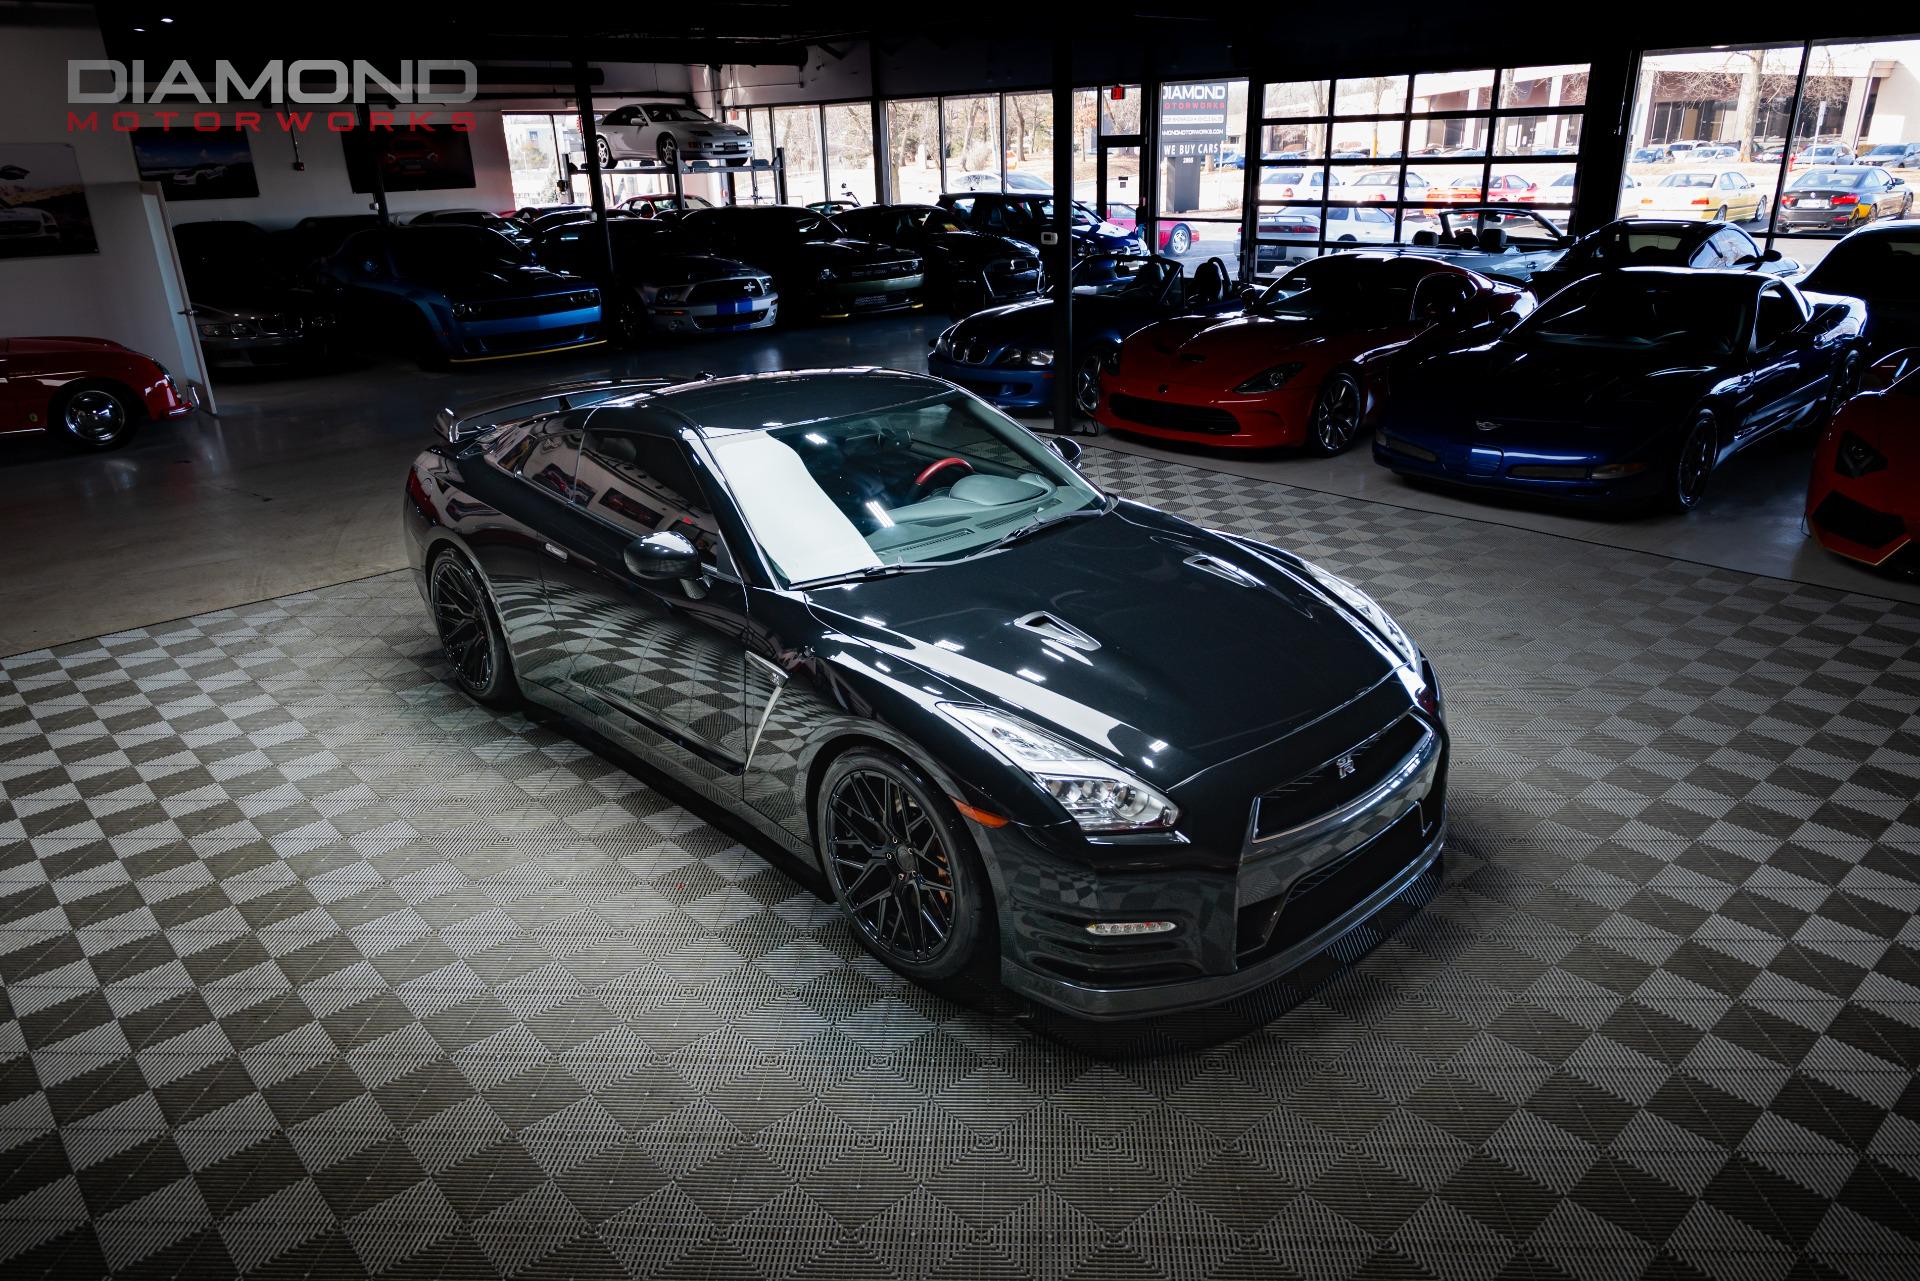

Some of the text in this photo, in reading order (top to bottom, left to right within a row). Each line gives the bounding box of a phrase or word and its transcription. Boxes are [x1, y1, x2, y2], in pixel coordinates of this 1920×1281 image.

[1163, 101, 1225, 110] OTORWORKS
[1164, 143, 1218, 154] WE BUY CARS
